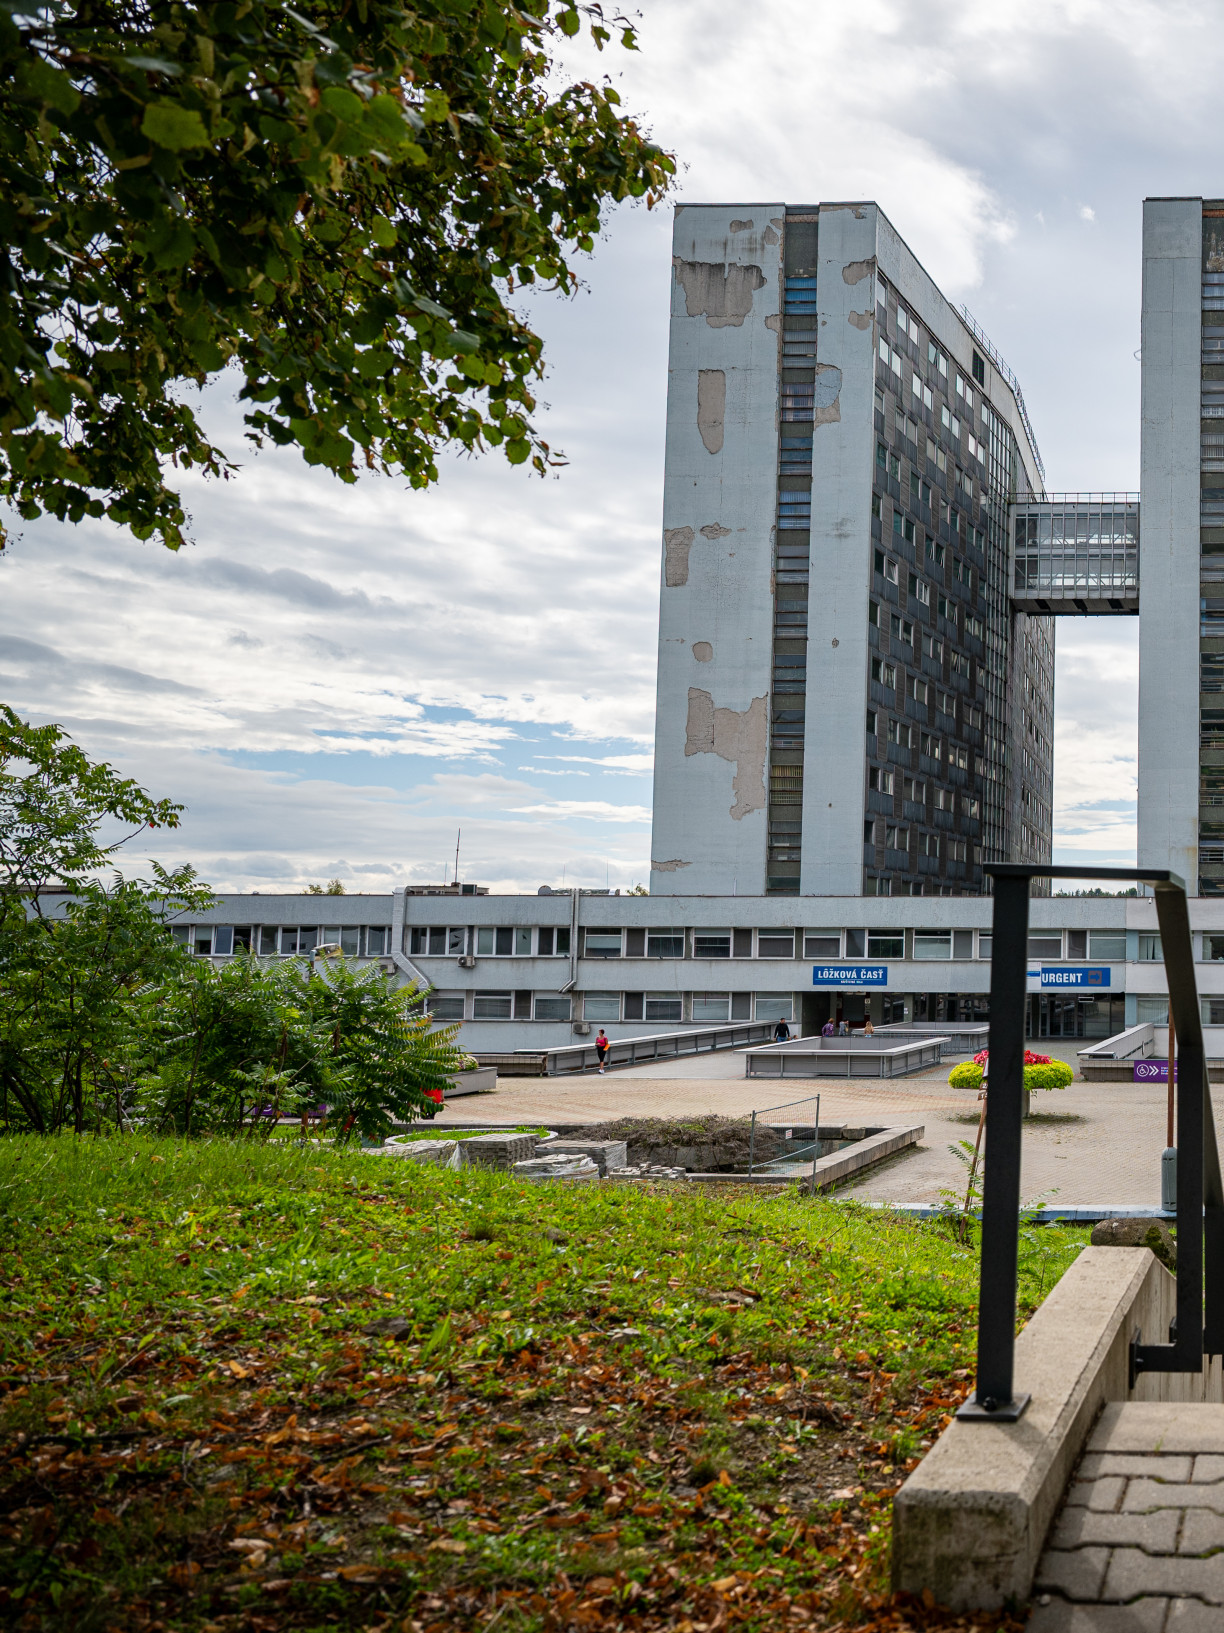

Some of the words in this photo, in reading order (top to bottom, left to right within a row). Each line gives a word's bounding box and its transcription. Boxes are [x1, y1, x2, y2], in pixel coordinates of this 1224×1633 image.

[818, 968, 857, 979] LÔŽKOVÁ
[860, 968, 884, 979] ČASŤ
[1041, 973, 1083, 983] URGENT
